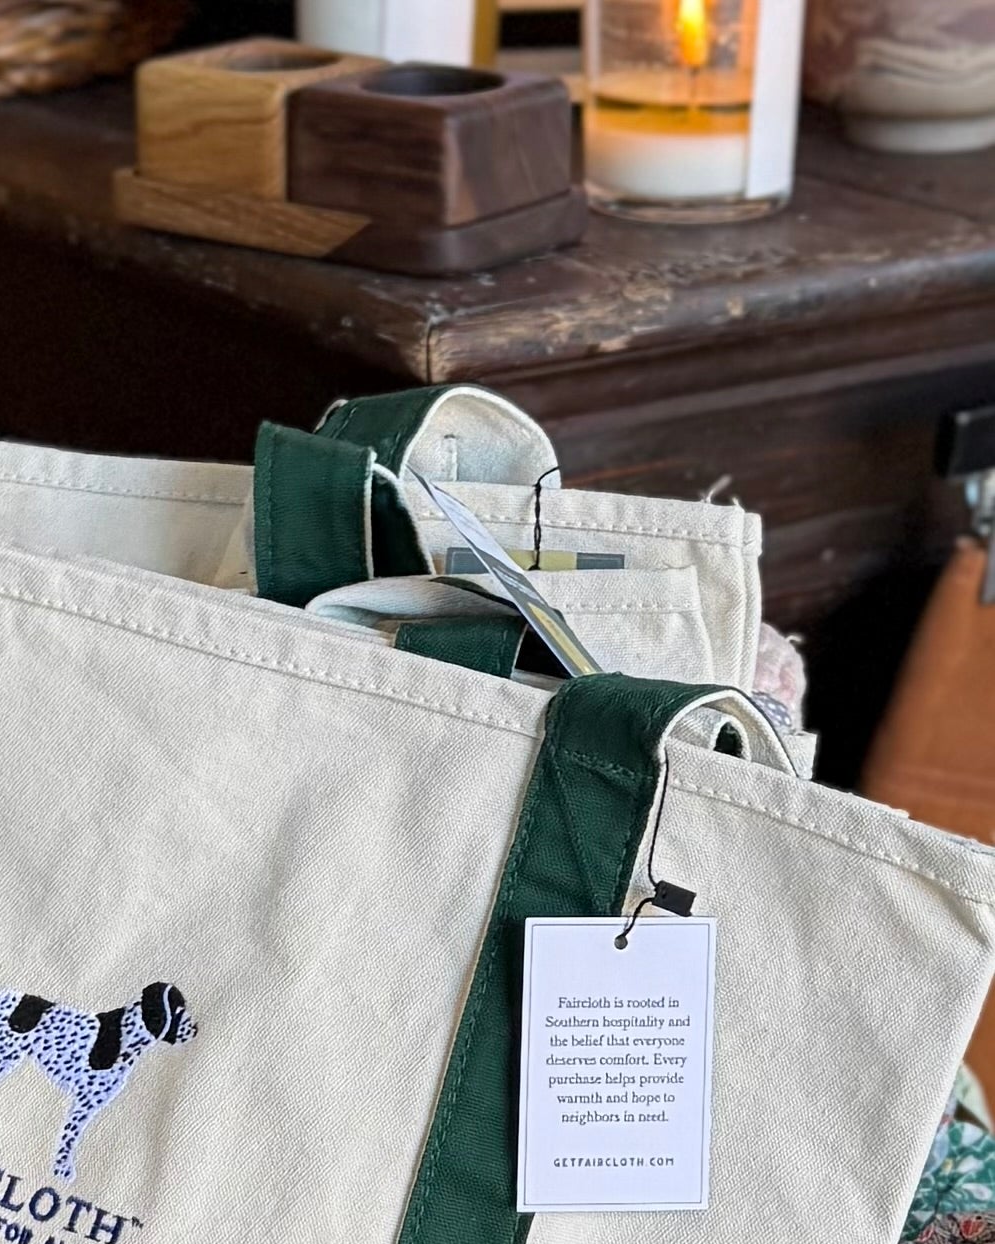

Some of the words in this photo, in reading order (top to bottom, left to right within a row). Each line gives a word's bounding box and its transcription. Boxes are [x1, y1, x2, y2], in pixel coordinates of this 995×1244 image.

[558, 997, 610, 1008] Faircloth
[614, 997, 624, 1008] is
[627, 996, 665, 1008] rooted
[668, 997, 679, 1008] in
[545, 1016, 599, 1027] Southern
[603, 1016, 665, 1031] hospitality
[668, 1015, 690, 1027] and
[550, 1035, 568, 1047] the
[572, 1034, 605, 1046] belief
[607, 1034, 629, 1046] that
[633, 1038, 685, 1049] everyone
[546, 1054, 596, 1065] deserves
[600, 1053, 649, 1065] comfort.
[654, 1053, 687, 1068] Every
[549, 1073, 601, 1088] purchase
[605, 1072, 635, 1087] helps
[639, 1072, 684, 1087] provide
[557, 1092, 602, 1104] warmth
[606, 1091, 628, 1103] and
[632, 1091, 660, 1106] hope
[664, 1093, 675, 1102] to
[562, 1111, 620, 1125] neighbors
[624, 1111, 635, 1122] in
[638, 1110, 668, 1122] need.
